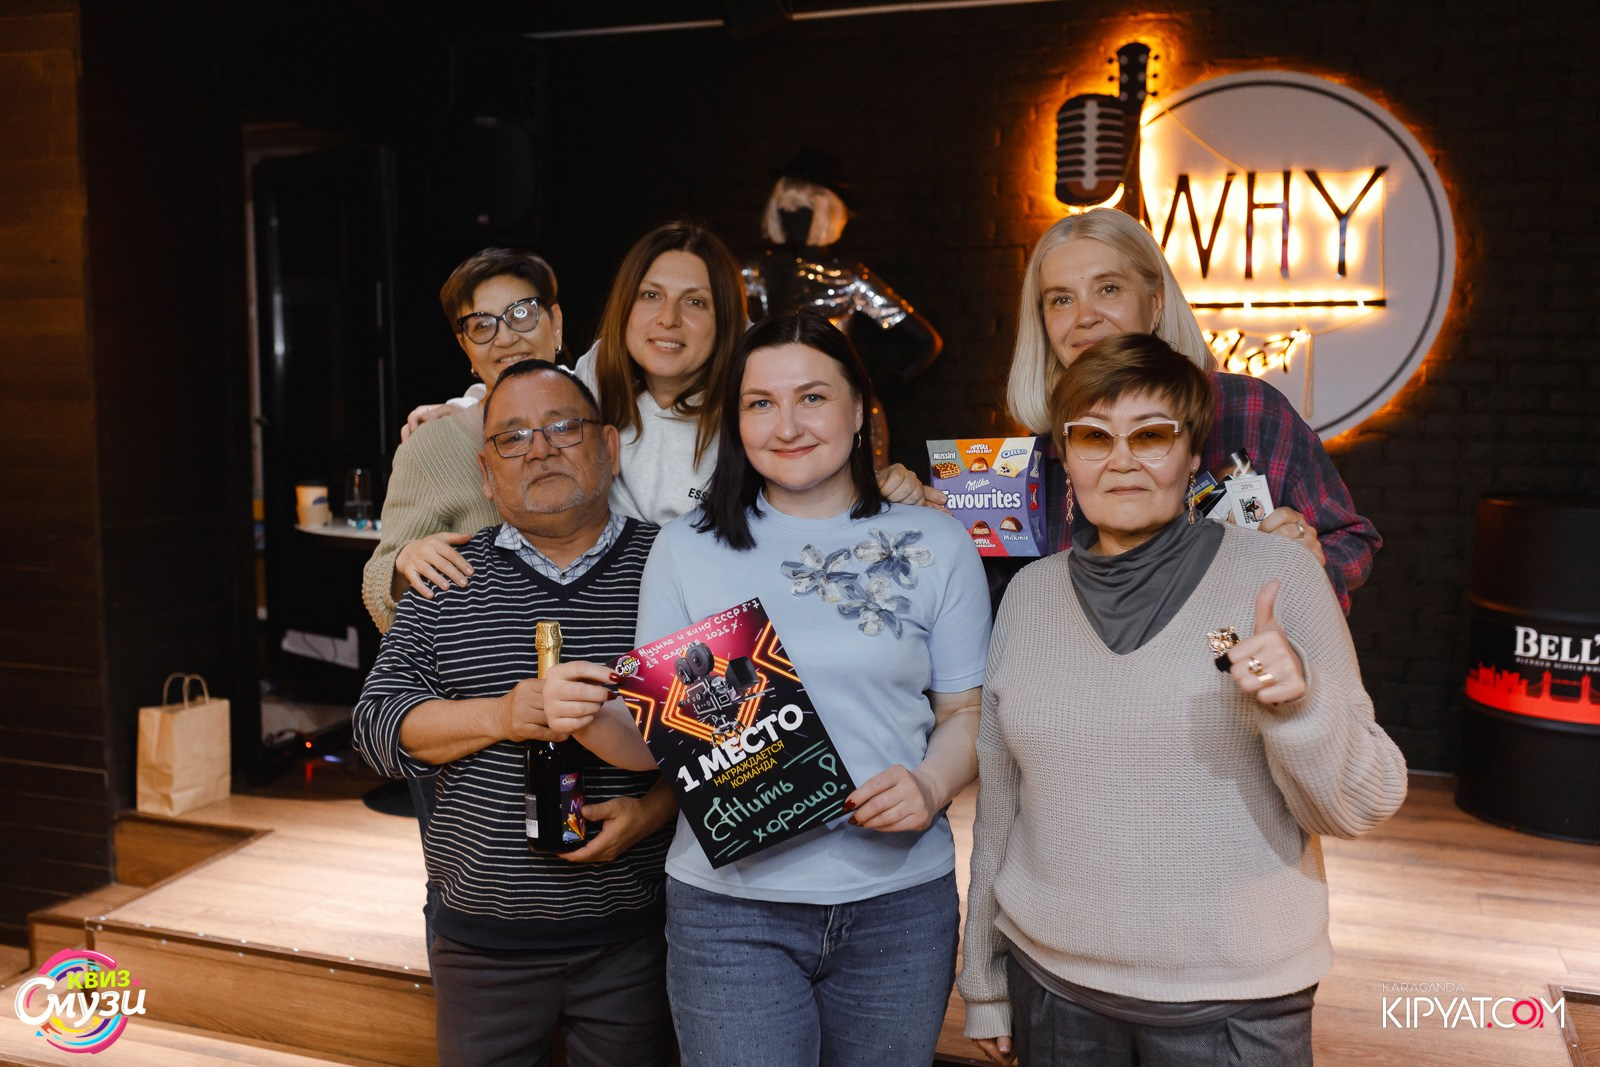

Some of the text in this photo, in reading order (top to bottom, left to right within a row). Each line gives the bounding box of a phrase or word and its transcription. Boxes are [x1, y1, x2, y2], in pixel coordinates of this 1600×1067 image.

[1139, 164, 1389, 280] WHY
[933, 451, 956, 460] Nussini
[1001, 448, 1028, 459] OREO
[965, 479, 991, 492] Milka
[638, 638, 675, 658] Музыка
[713, 608, 740, 625] СССР
[646, 658, 659, 669] 17
[705, 624, 730, 641] 2025
[615, 658, 641, 676] Смузи
[677, 704, 804, 793] 1 МЕСТО
[713, 740, 785, 787] НАГРАЖДАЕТСЯ
[730, 757, 778, 789] КОМАНДА
